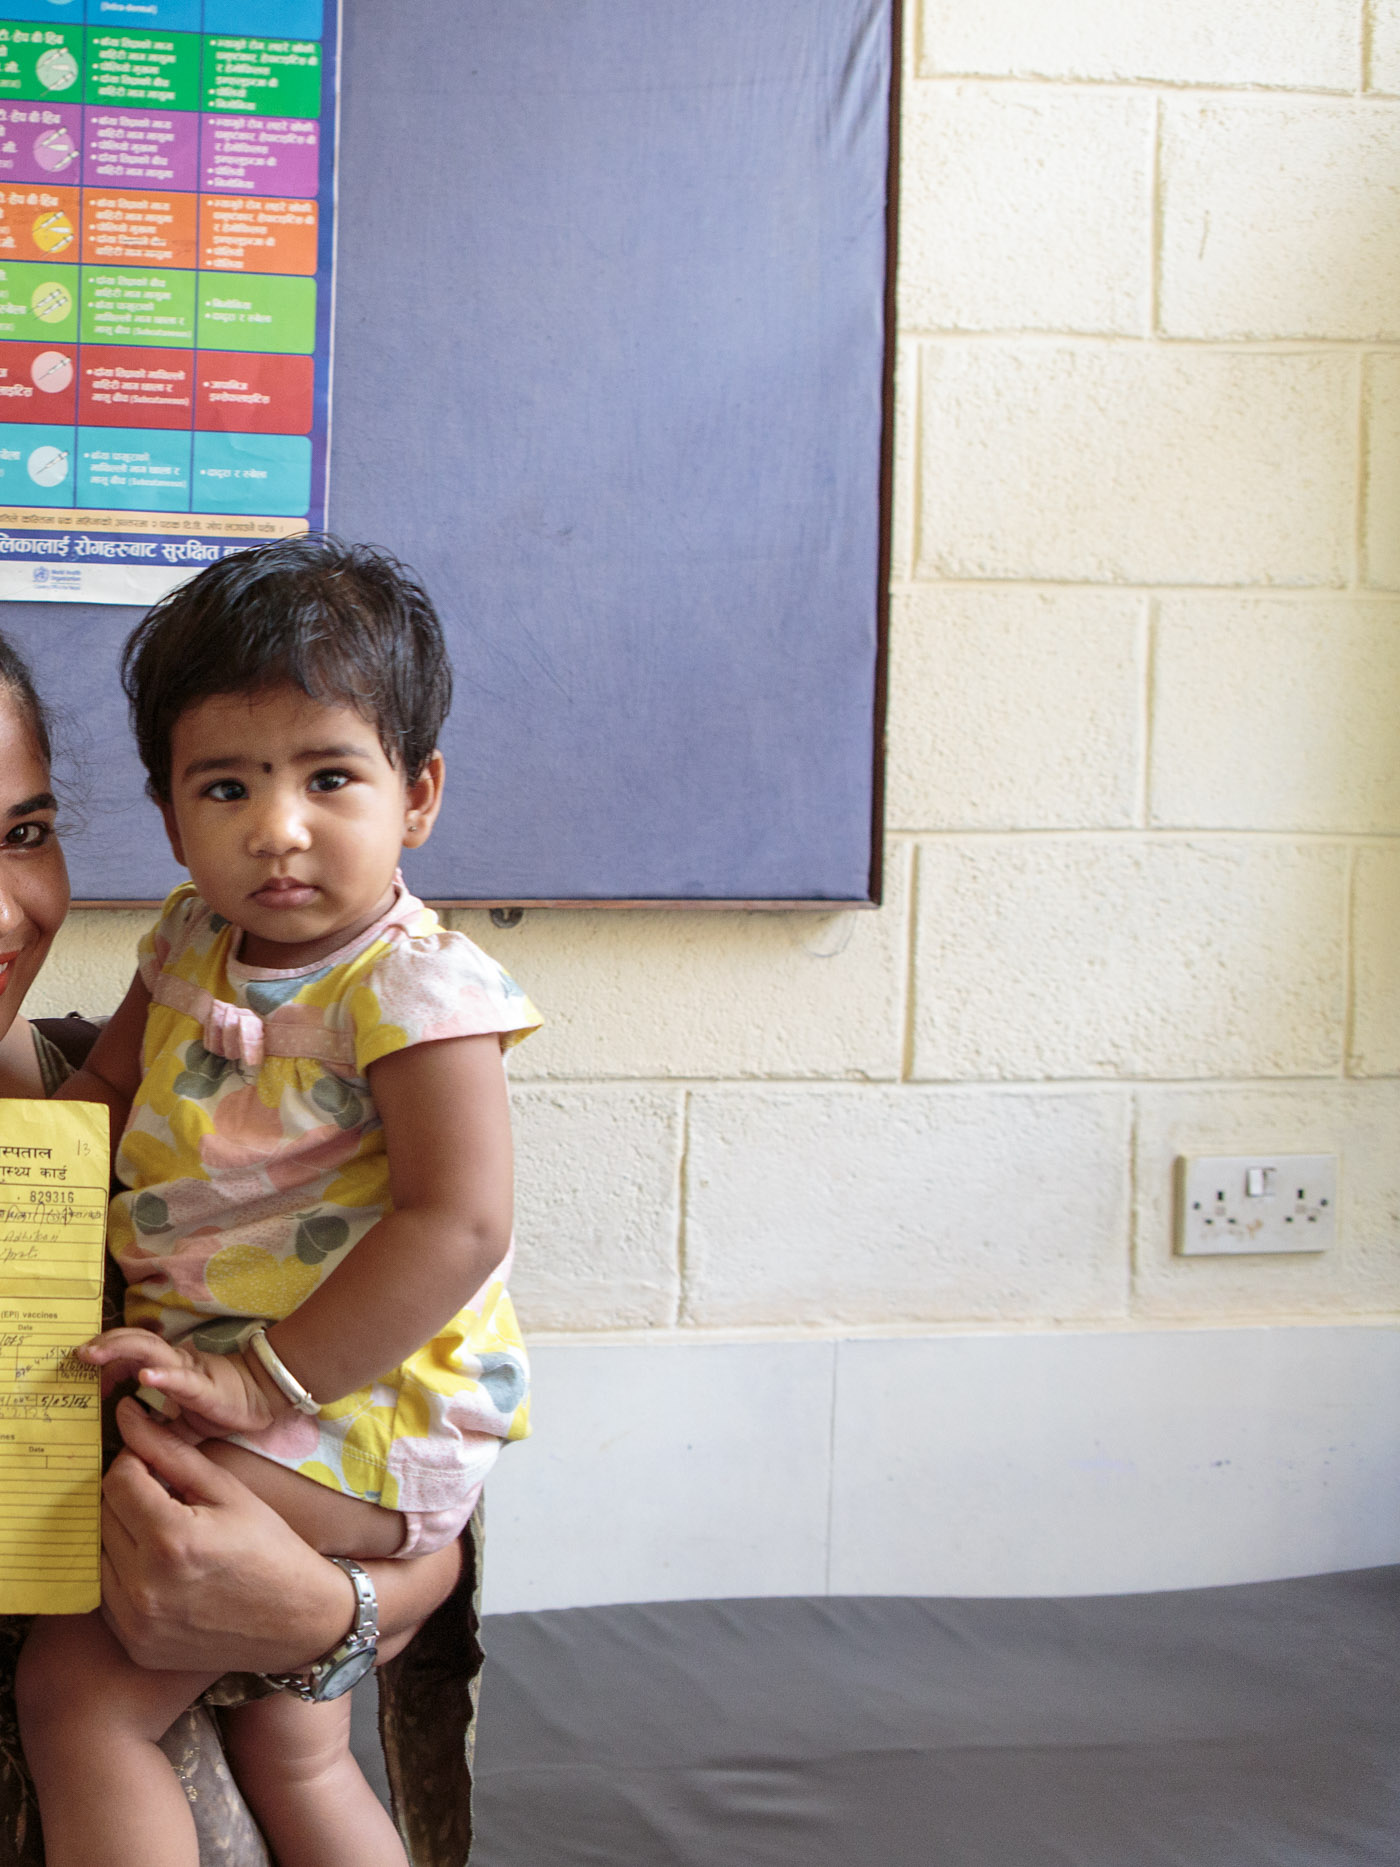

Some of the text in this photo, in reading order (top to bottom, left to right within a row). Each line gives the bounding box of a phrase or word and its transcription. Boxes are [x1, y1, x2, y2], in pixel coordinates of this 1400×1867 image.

[161, 540, 219, 562] सुरक्षित
[40, 1164, 68, 1181] कार्ड
[29, 1190, 74, 1204] 829316
[0, 1311, 20, 1320] (EPI)
[22, 1312, 58, 1320] vaccines
